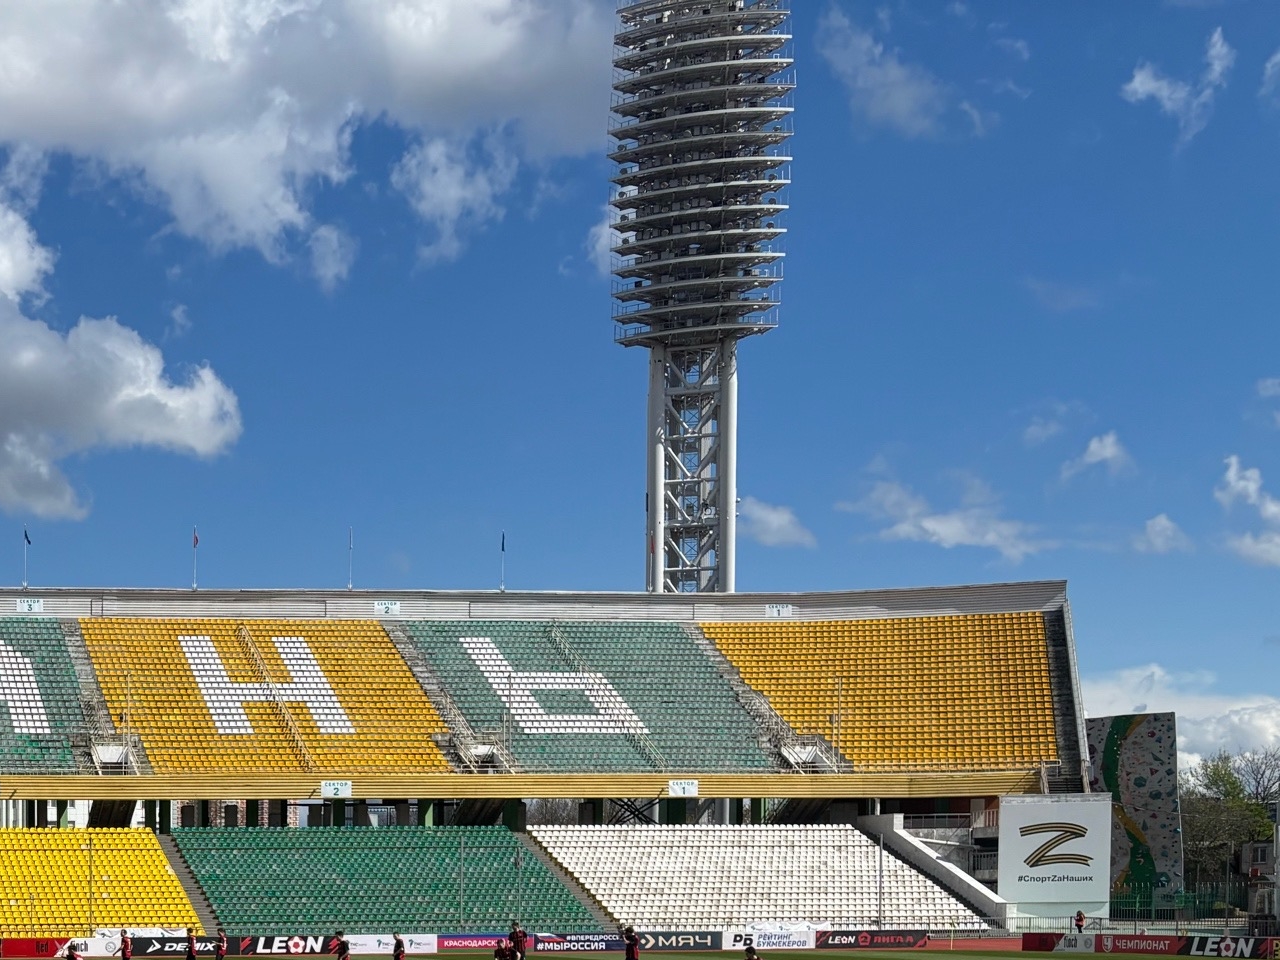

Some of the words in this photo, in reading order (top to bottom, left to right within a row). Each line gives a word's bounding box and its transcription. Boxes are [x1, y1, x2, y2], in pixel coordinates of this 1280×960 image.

[333, 787, 340, 796] 2
[682, 787, 686, 795] 1
[658, 935, 711, 946] МЯЧ
[758, 932, 793, 940] РЕЙТИНГ
[828, 935, 856, 944] LEON
[163, 942, 215, 951] DEIX
[256, 937, 324, 954] LEON
[536, 942, 606, 951] #МЫРОССИЯ
[1115, 939, 1170, 950] ЧЕМПИОНАТ
[1190, 937, 1255, 957] LEON
